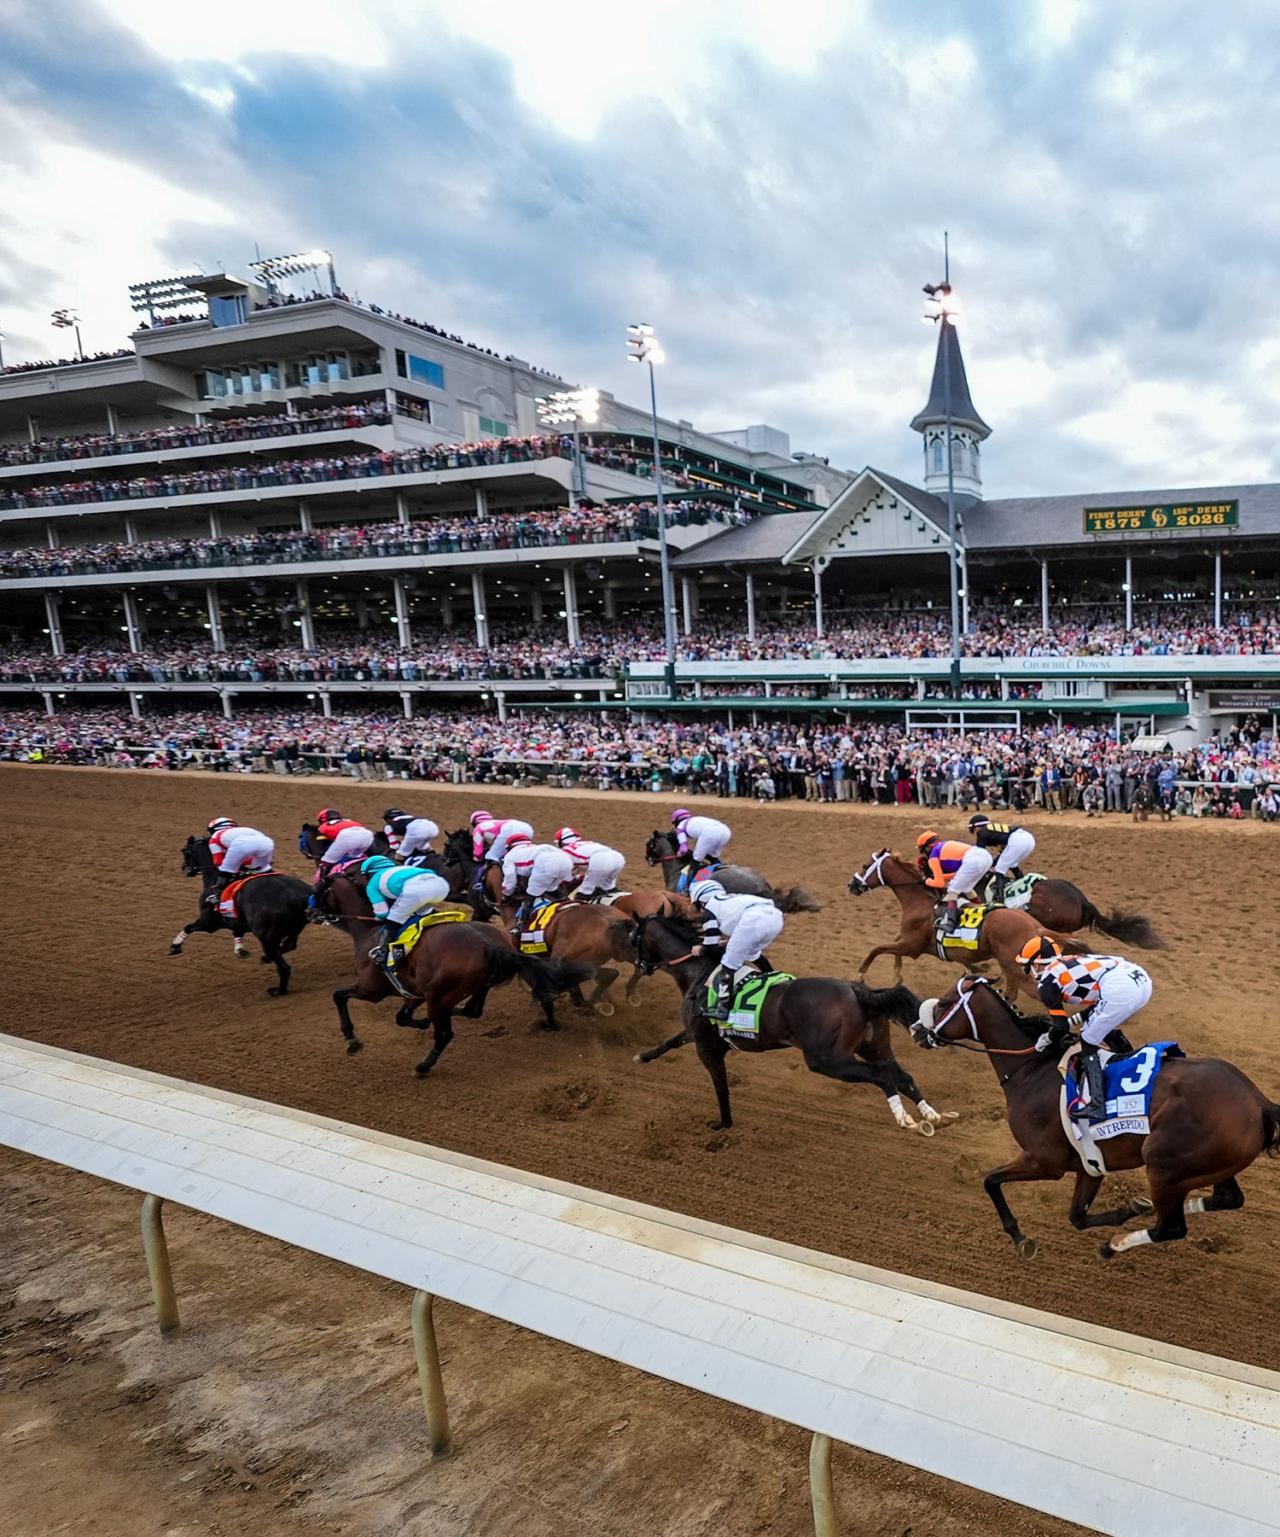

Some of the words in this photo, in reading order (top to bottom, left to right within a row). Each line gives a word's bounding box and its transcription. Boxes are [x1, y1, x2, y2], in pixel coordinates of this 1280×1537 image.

[1197, 504, 1232, 514] DERBY
[1093, 517, 1141, 530] 1875
[1176, 512, 1225, 526] 2026
[1120, 1047, 1158, 1093] 3
[1096, 1119, 1146, 1137] INTREPIDO
